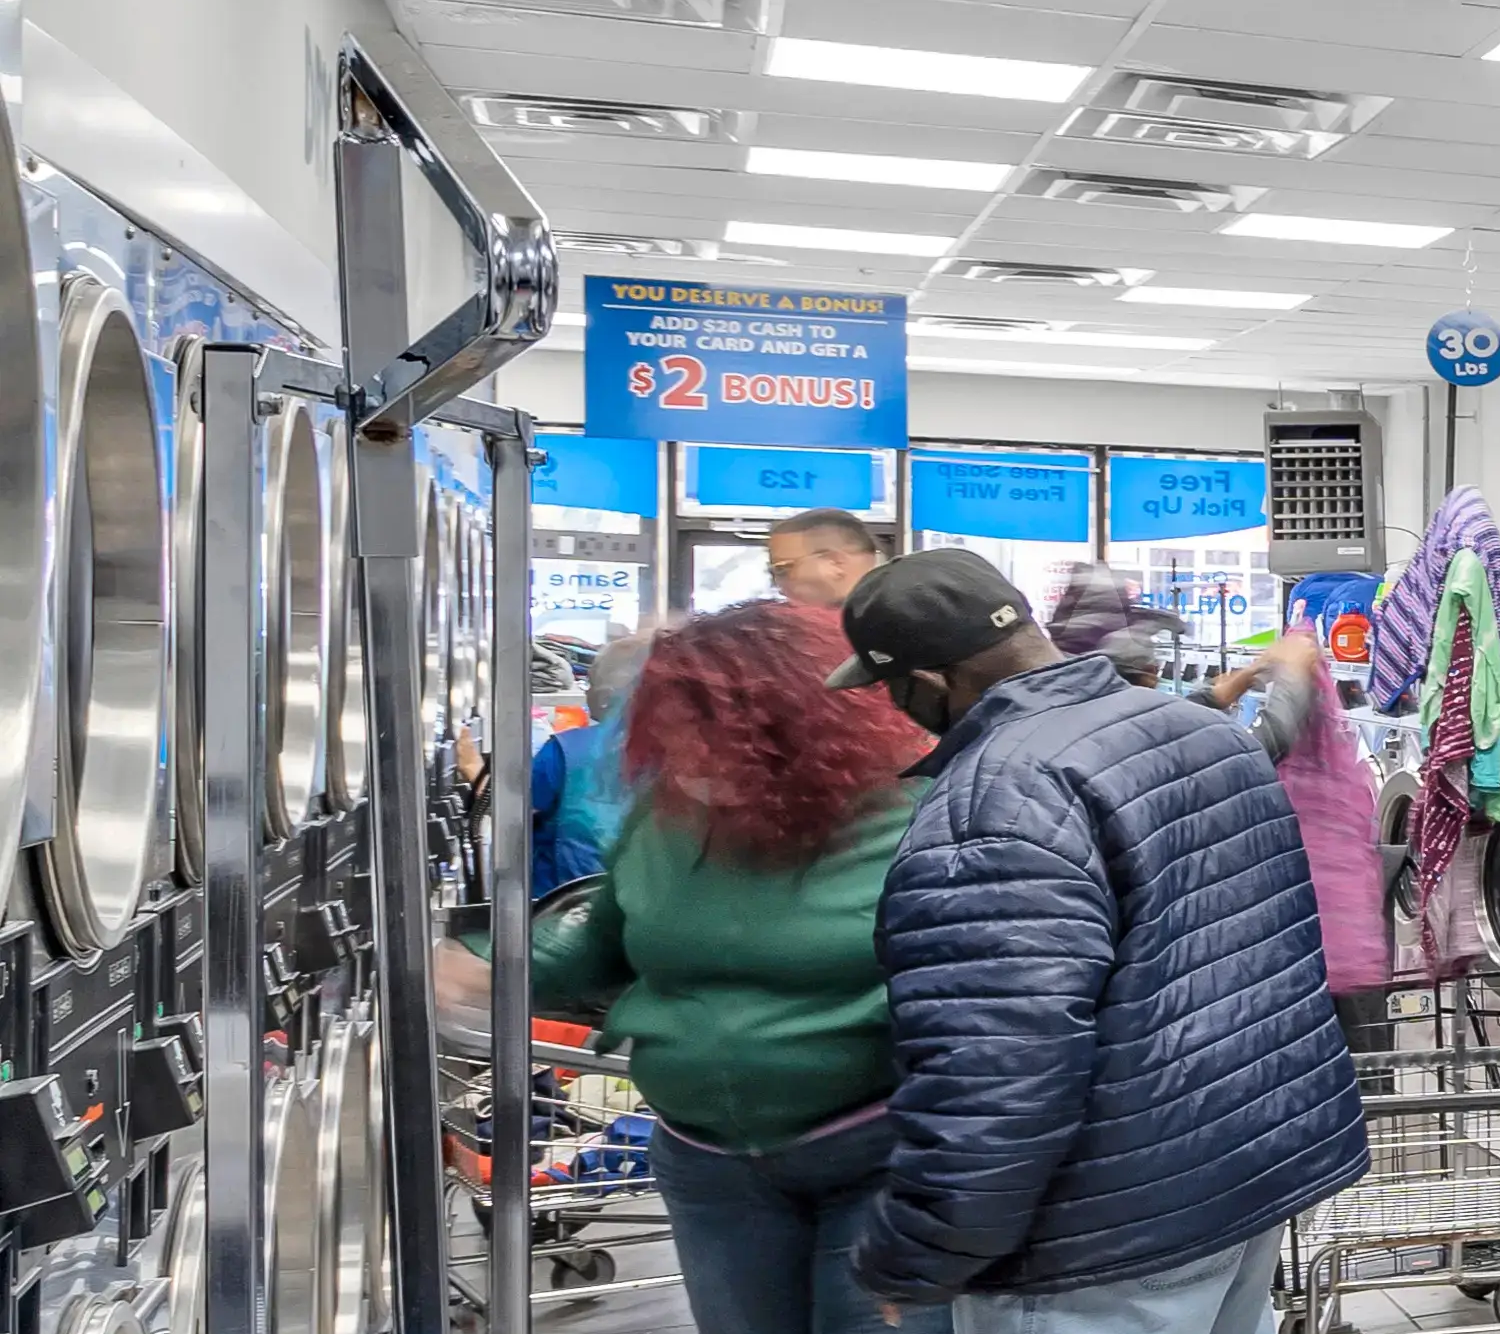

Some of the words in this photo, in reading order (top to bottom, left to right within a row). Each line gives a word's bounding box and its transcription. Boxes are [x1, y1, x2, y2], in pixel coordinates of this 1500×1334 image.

[612, 284, 664, 301] YOU
[671, 287, 770, 308] DESERVE
[777, 296, 794, 309] A
[801, 297, 884, 314] BONUS!
[650, 316, 699, 331] ADD
[702, 318, 742, 335] $20
[749, 321, 802, 338] CASH
[809, 325, 836, 339] TO
[626, 331, 686, 349] YOUR
[696, 336, 752, 353] CARD
[761, 340, 806, 356] AND
[810, 344, 849, 358] GET
[852, 345, 868, 359] A
[1437, 327, 1498, 360] 30
[628, 354, 708, 410] $2
[721, 372, 875, 410] BONUS!
[1455, 362, 1488, 377] Lbs
